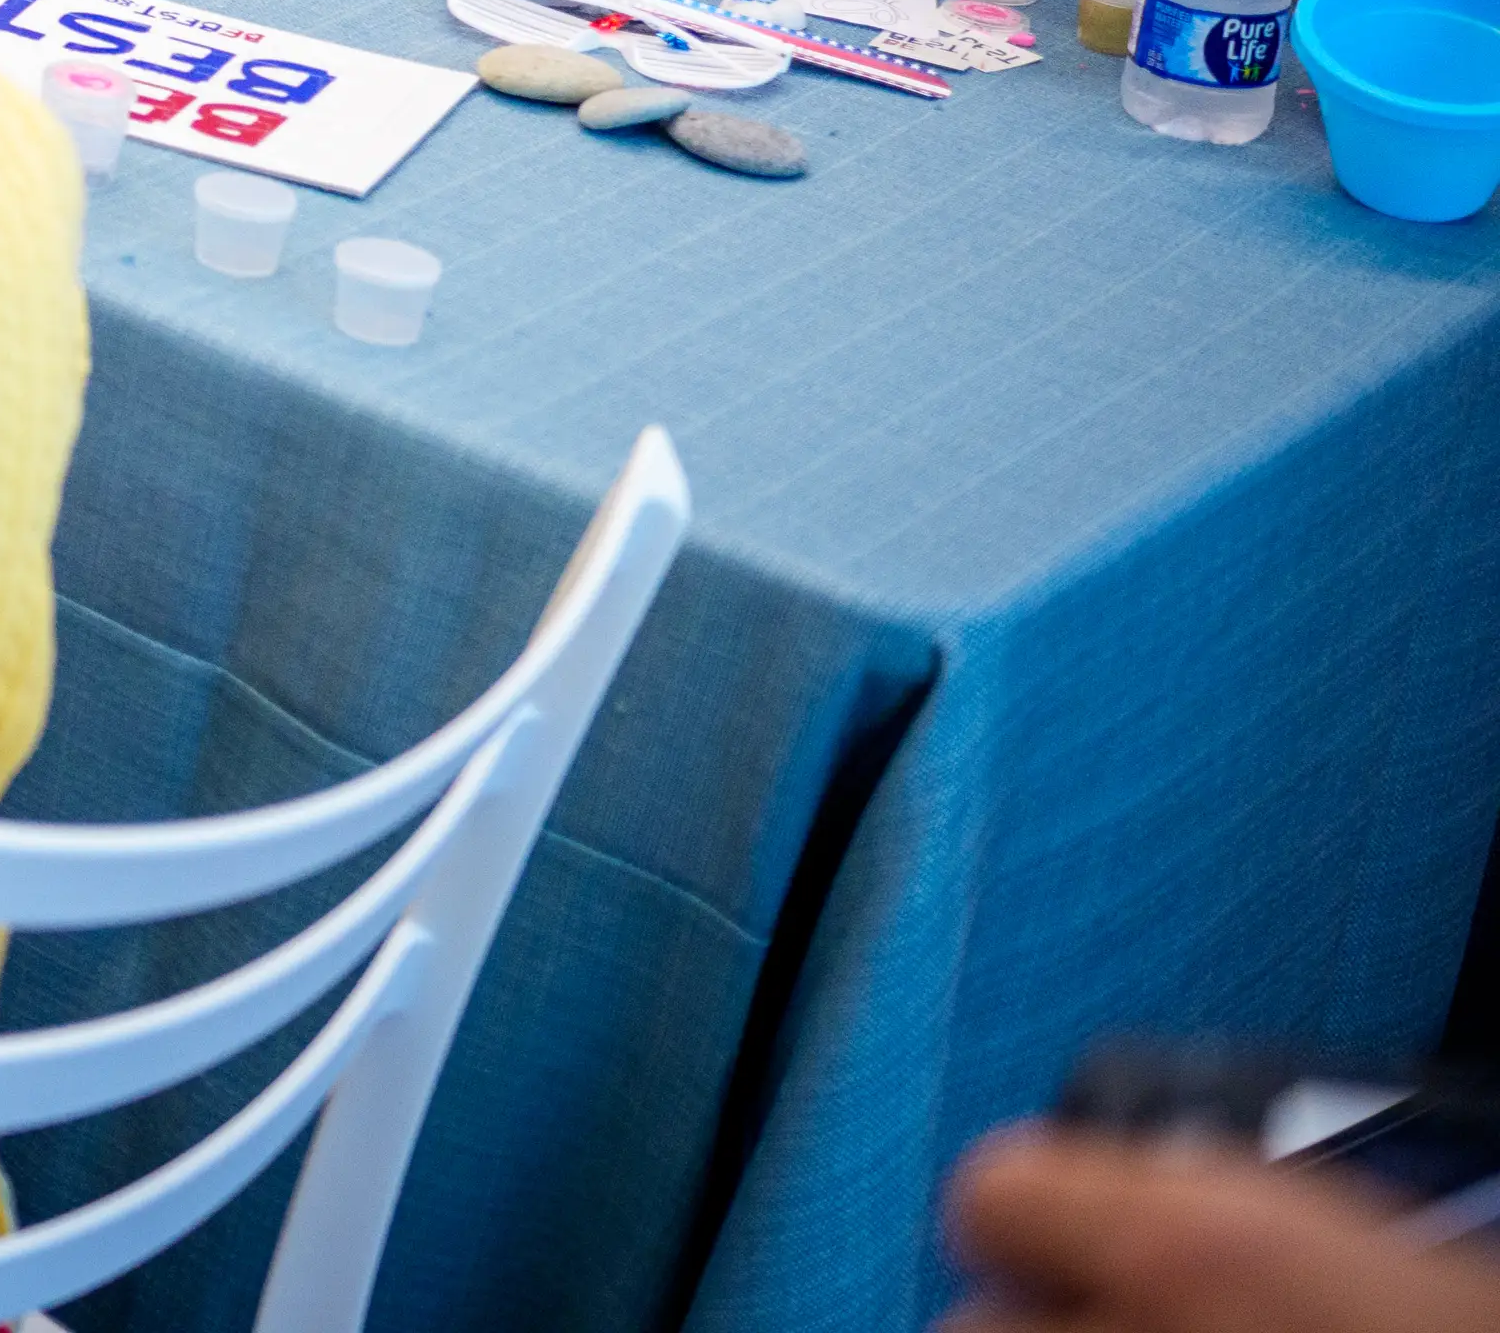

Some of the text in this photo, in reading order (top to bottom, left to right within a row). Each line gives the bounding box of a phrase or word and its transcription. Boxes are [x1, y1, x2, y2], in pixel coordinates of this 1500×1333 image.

[1222, 18, 1276, 40] Pure
[1226, 39, 1269, 66] Life
[126, 78, 289, 148] BE
